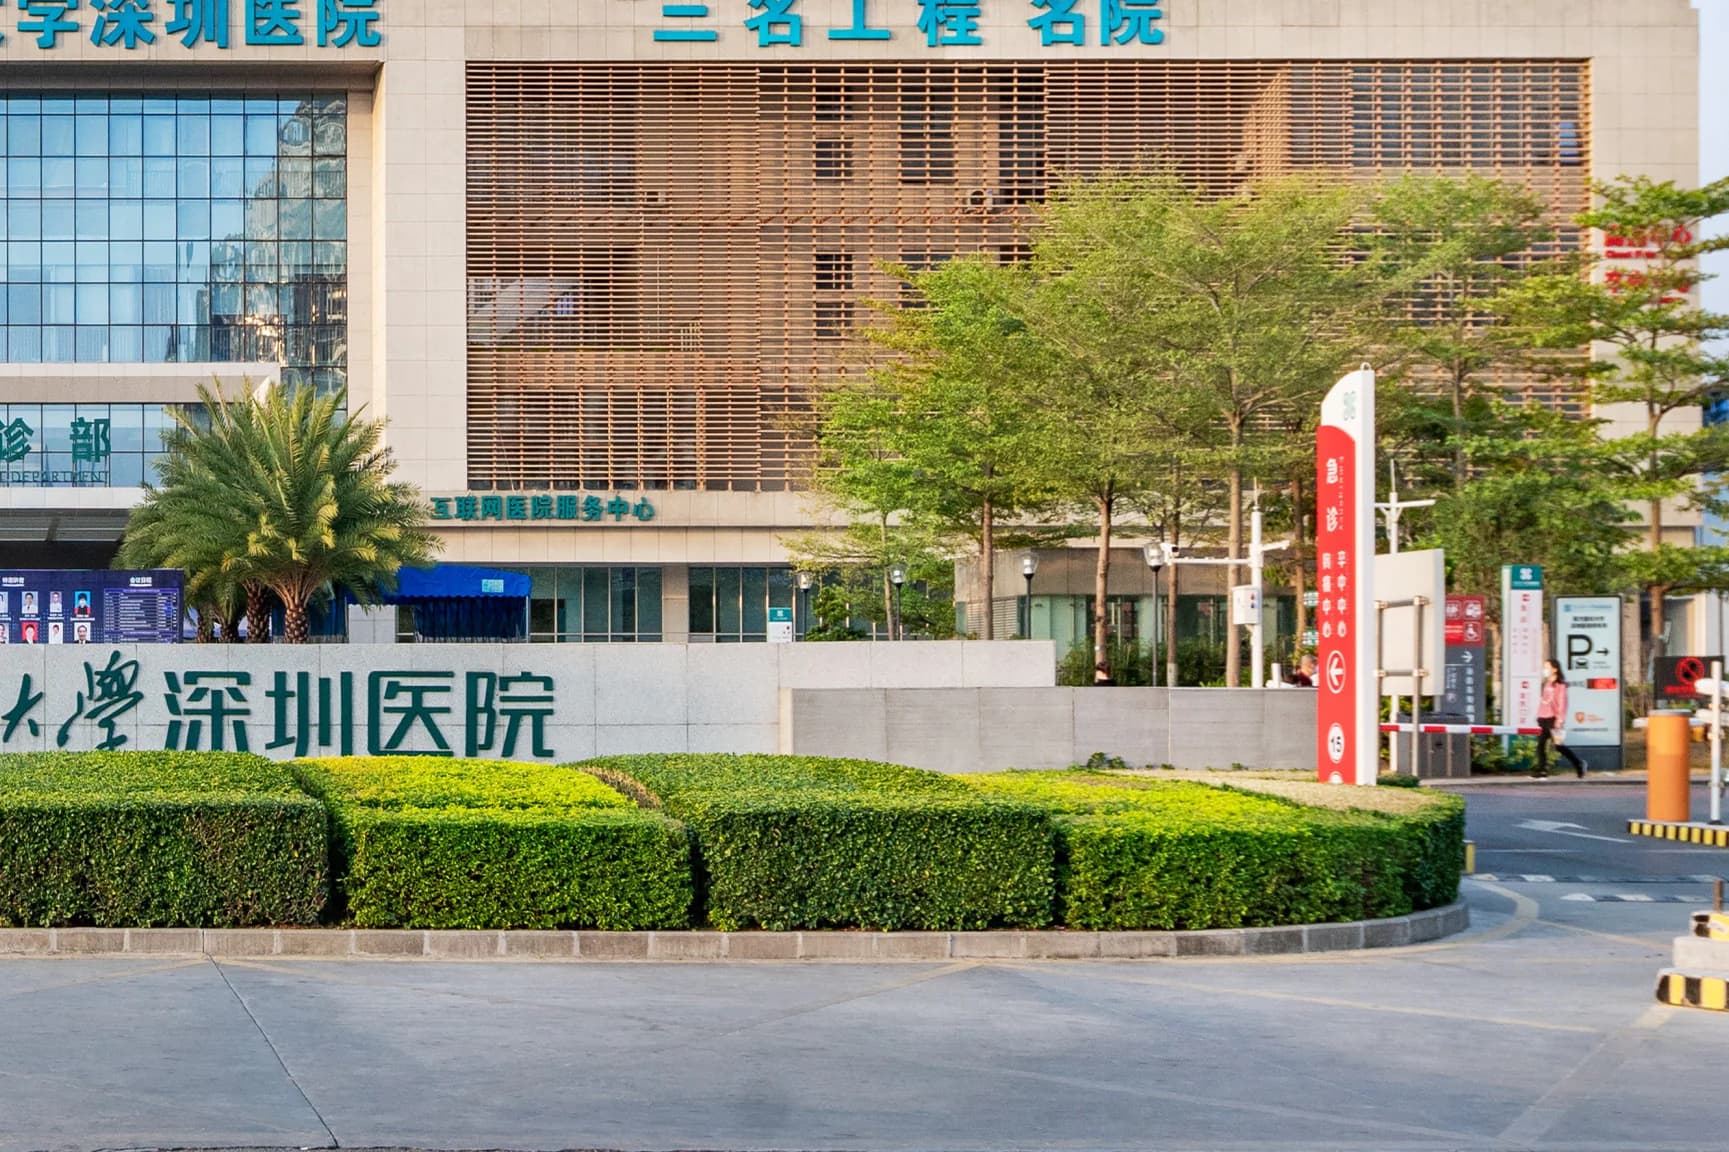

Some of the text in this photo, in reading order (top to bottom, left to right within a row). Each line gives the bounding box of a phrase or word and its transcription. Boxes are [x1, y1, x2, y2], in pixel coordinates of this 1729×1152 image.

[430, 494, 656, 522] 互联网医院服务中心
[1567, 634, 1594, 671] P
